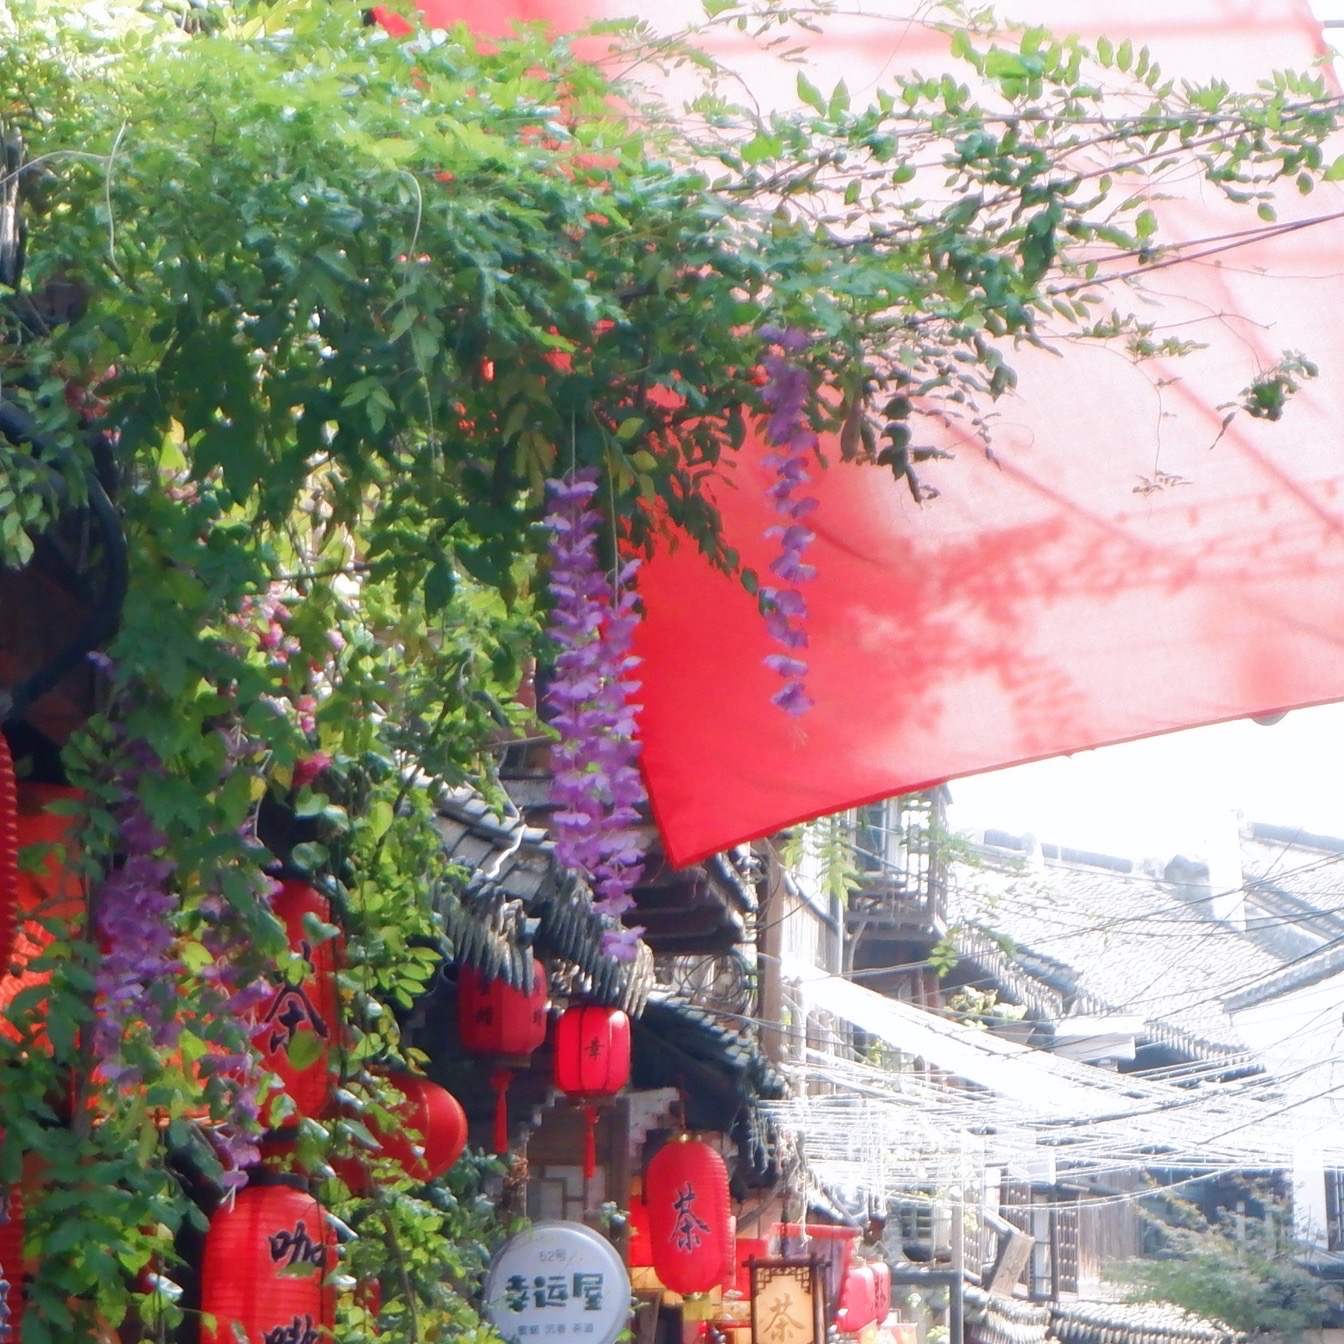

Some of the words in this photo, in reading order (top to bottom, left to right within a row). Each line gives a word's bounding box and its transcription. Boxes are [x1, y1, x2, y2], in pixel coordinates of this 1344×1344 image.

[669, 1181, 710, 1250] 茶
[505, 1272, 604, 1312] 幸运屋
[763, 1293, 806, 1344] 茶
